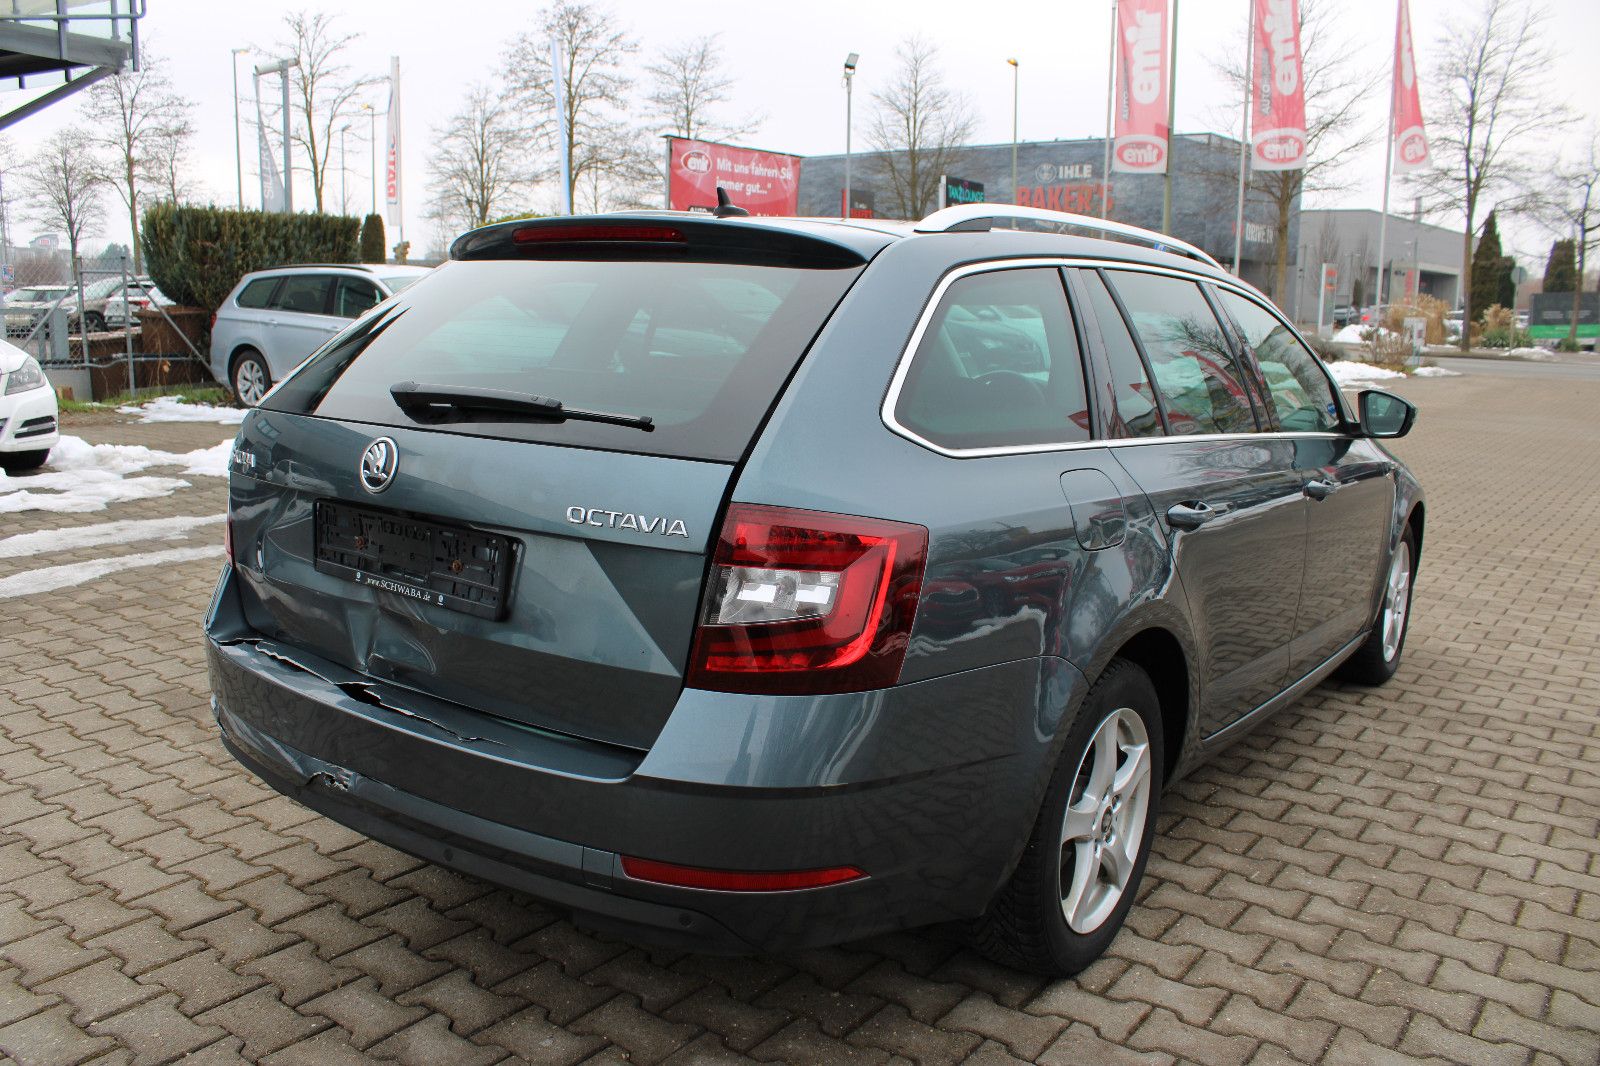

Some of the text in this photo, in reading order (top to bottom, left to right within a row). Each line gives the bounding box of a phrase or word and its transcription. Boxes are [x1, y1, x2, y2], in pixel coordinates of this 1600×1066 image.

[1125, 9, 1161, 105] emir
[717, 157, 732, 172] Mit
[734, 163, 749, 174] uns
[751, 161, 778, 177] fahren
[1059, 164, 1092, 178] IHLE
[716, 176, 744, 191] immer
[566, 506, 689, 538] OCTAVIA
